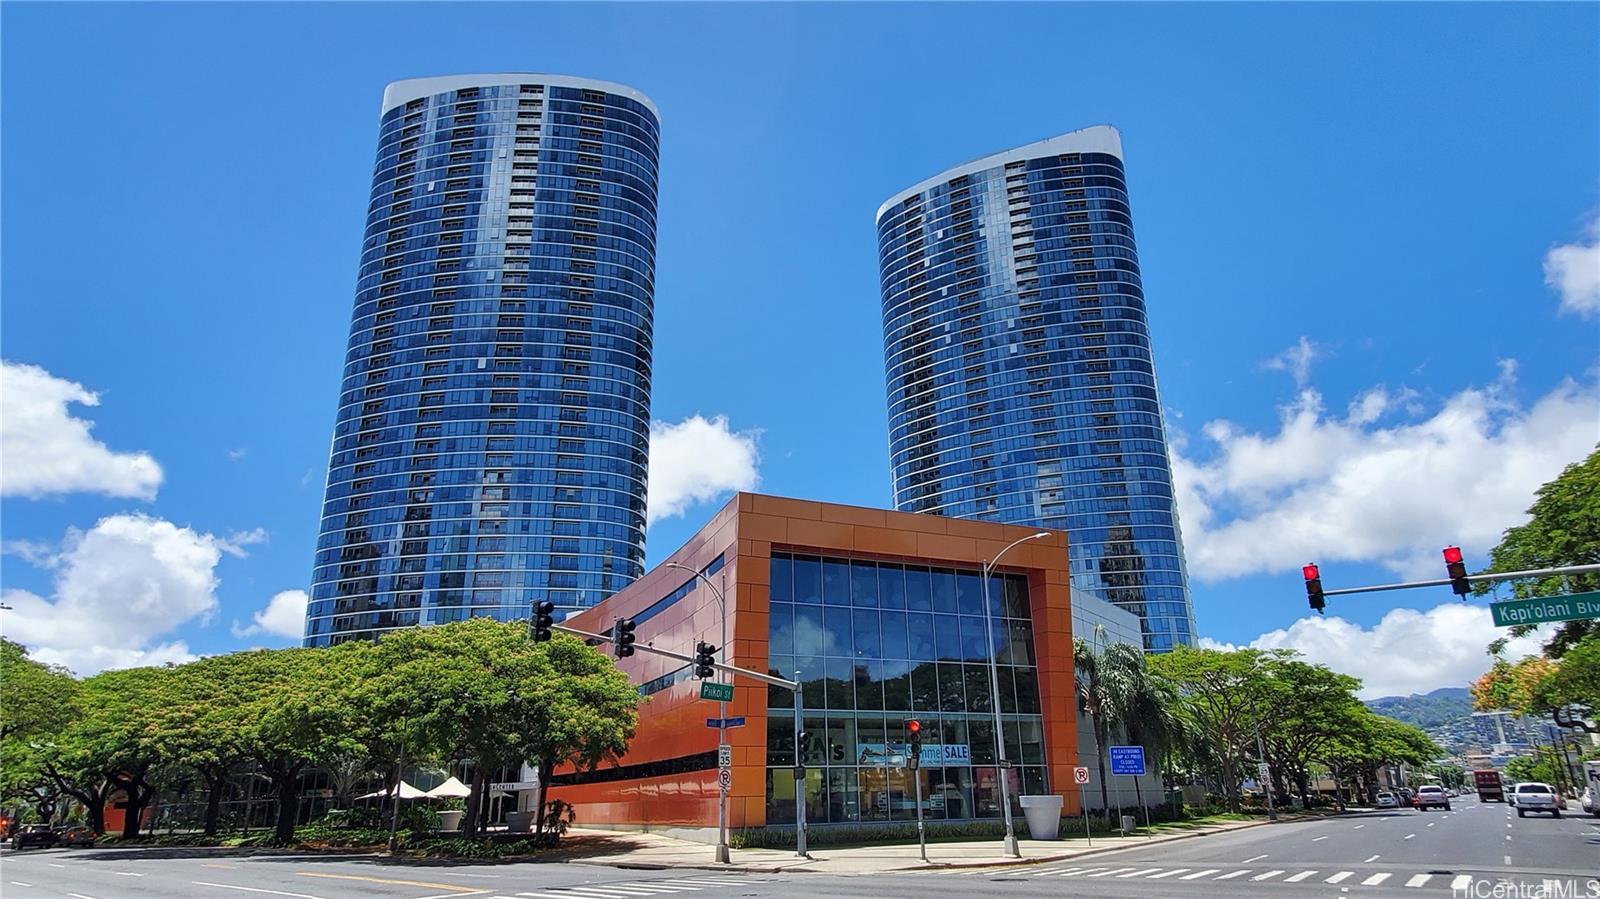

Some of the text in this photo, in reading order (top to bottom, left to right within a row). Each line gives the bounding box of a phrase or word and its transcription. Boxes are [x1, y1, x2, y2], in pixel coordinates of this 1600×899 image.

[703, 685, 731, 699] Piikoi St
[945, 746, 967, 758] SALE
[720, 756, 730, 765] 35
